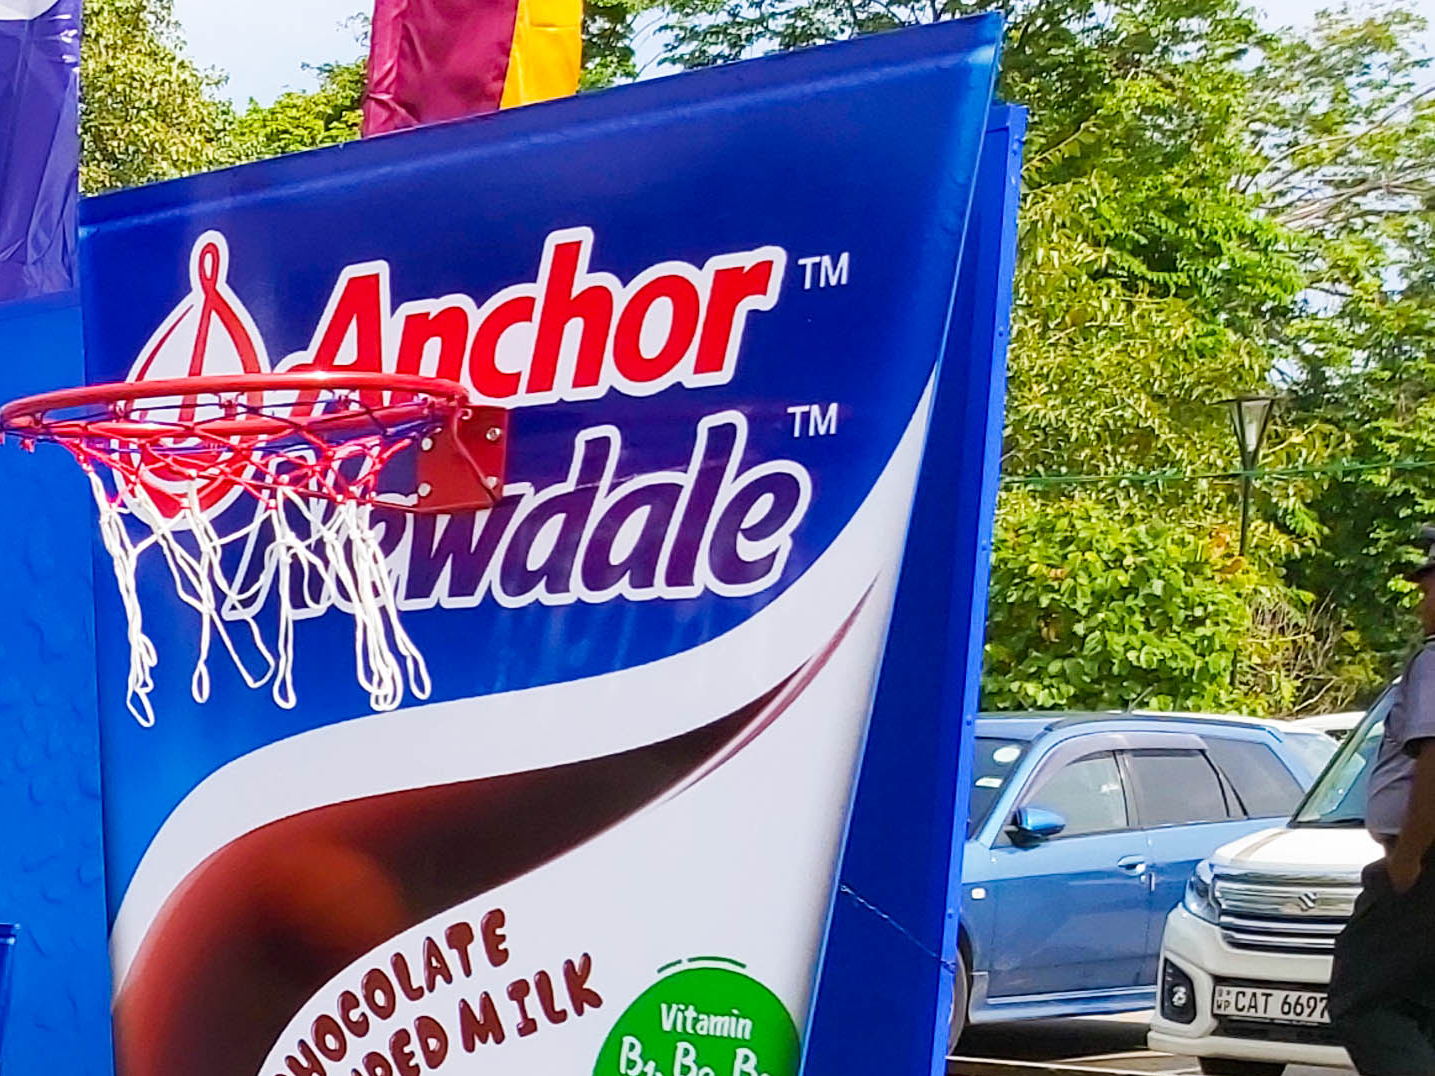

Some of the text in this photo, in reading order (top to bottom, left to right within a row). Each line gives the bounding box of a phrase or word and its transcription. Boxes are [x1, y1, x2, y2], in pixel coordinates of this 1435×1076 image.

[275, 227, 786, 420] Anchor
[223, 412, 812, 620] Newdale
[459, 953, 603, 1053] MILK
[660, 1003, 752, 1040] Vitamin
[1235, 991, 1329, 1018] CAT 6697
